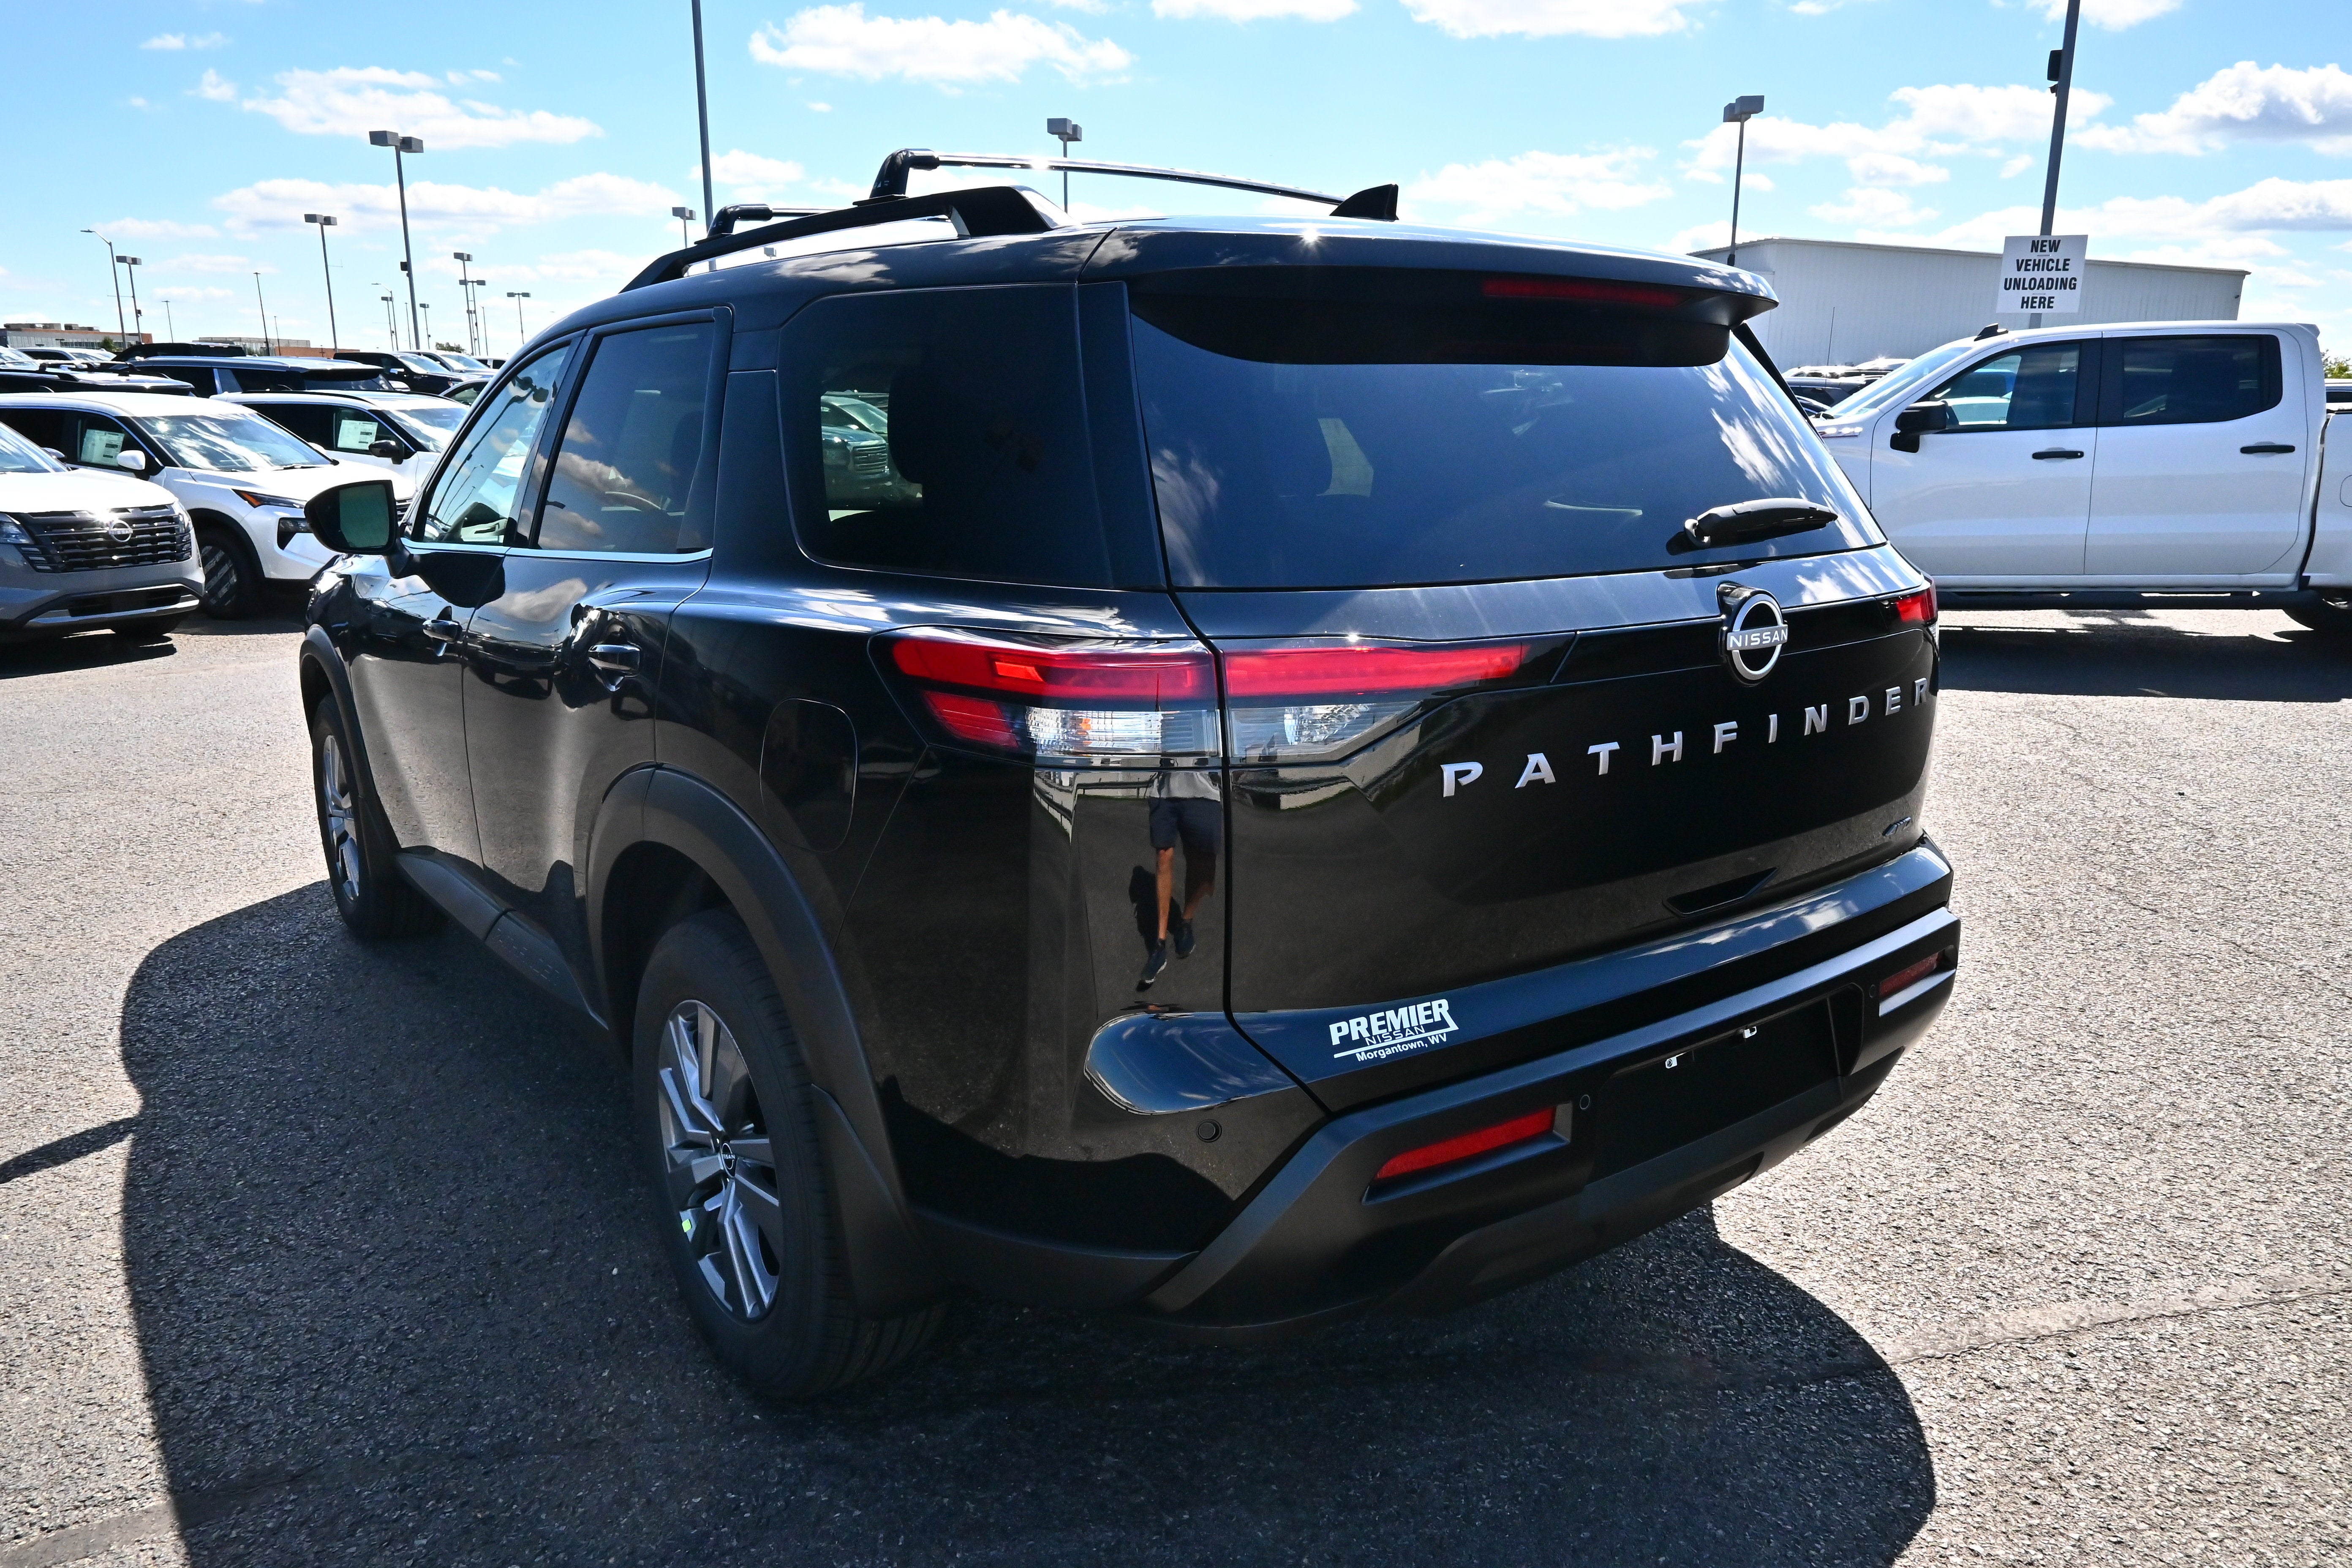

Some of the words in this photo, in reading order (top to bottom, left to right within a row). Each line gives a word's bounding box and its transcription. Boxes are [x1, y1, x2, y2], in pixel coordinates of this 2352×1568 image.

[2031, 240, 2061, 253] NEW
[2016, 259, 2070, 271] VEHICLE
[2004, 277, 2077, 290] UNLOADING
[2021, 297, 2055, 309] HERE
[1730, 628, 1787, 647] NISSAN
[1440, 677, 1927, 798] PATHFINDER
[1329, 999, 1459, 1045] PREMIER
[1365, 1025, 1425, 1045] NISSAN
[1356, 1039, 1428, 1062] Morgantown,
[1428, 1033, 1447, 1045] WV
